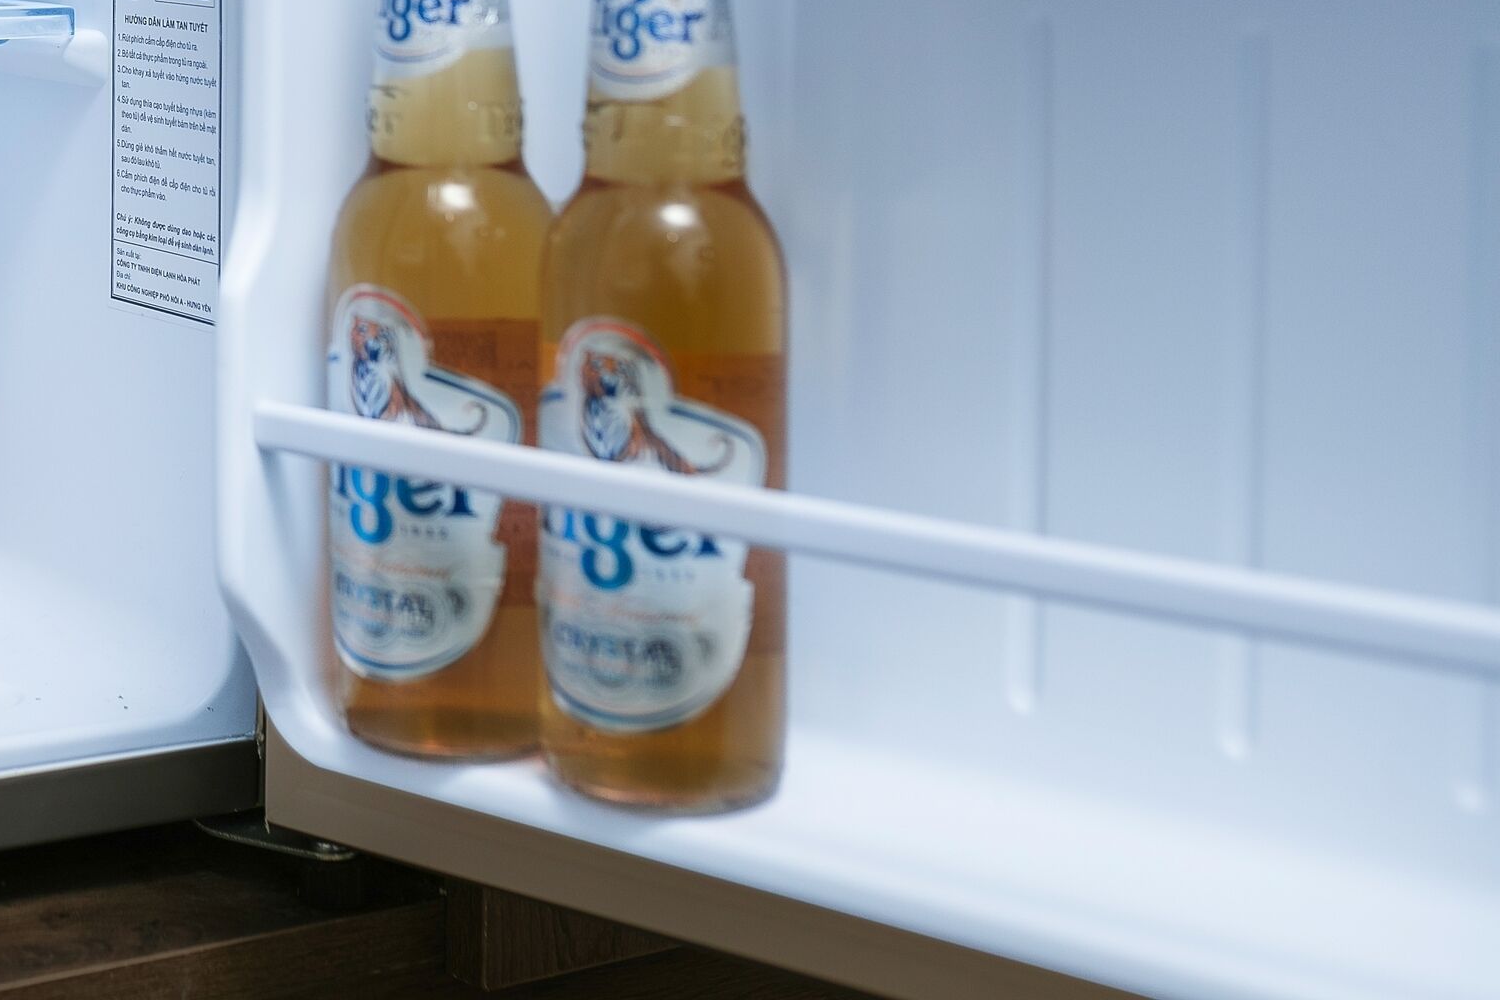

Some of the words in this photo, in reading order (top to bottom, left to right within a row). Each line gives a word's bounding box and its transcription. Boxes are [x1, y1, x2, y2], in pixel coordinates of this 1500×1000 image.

[177, 21, 187, 30] TAN
[138, 264, 151, 274] TNHH
[117, 282, 126, 290] KHU
